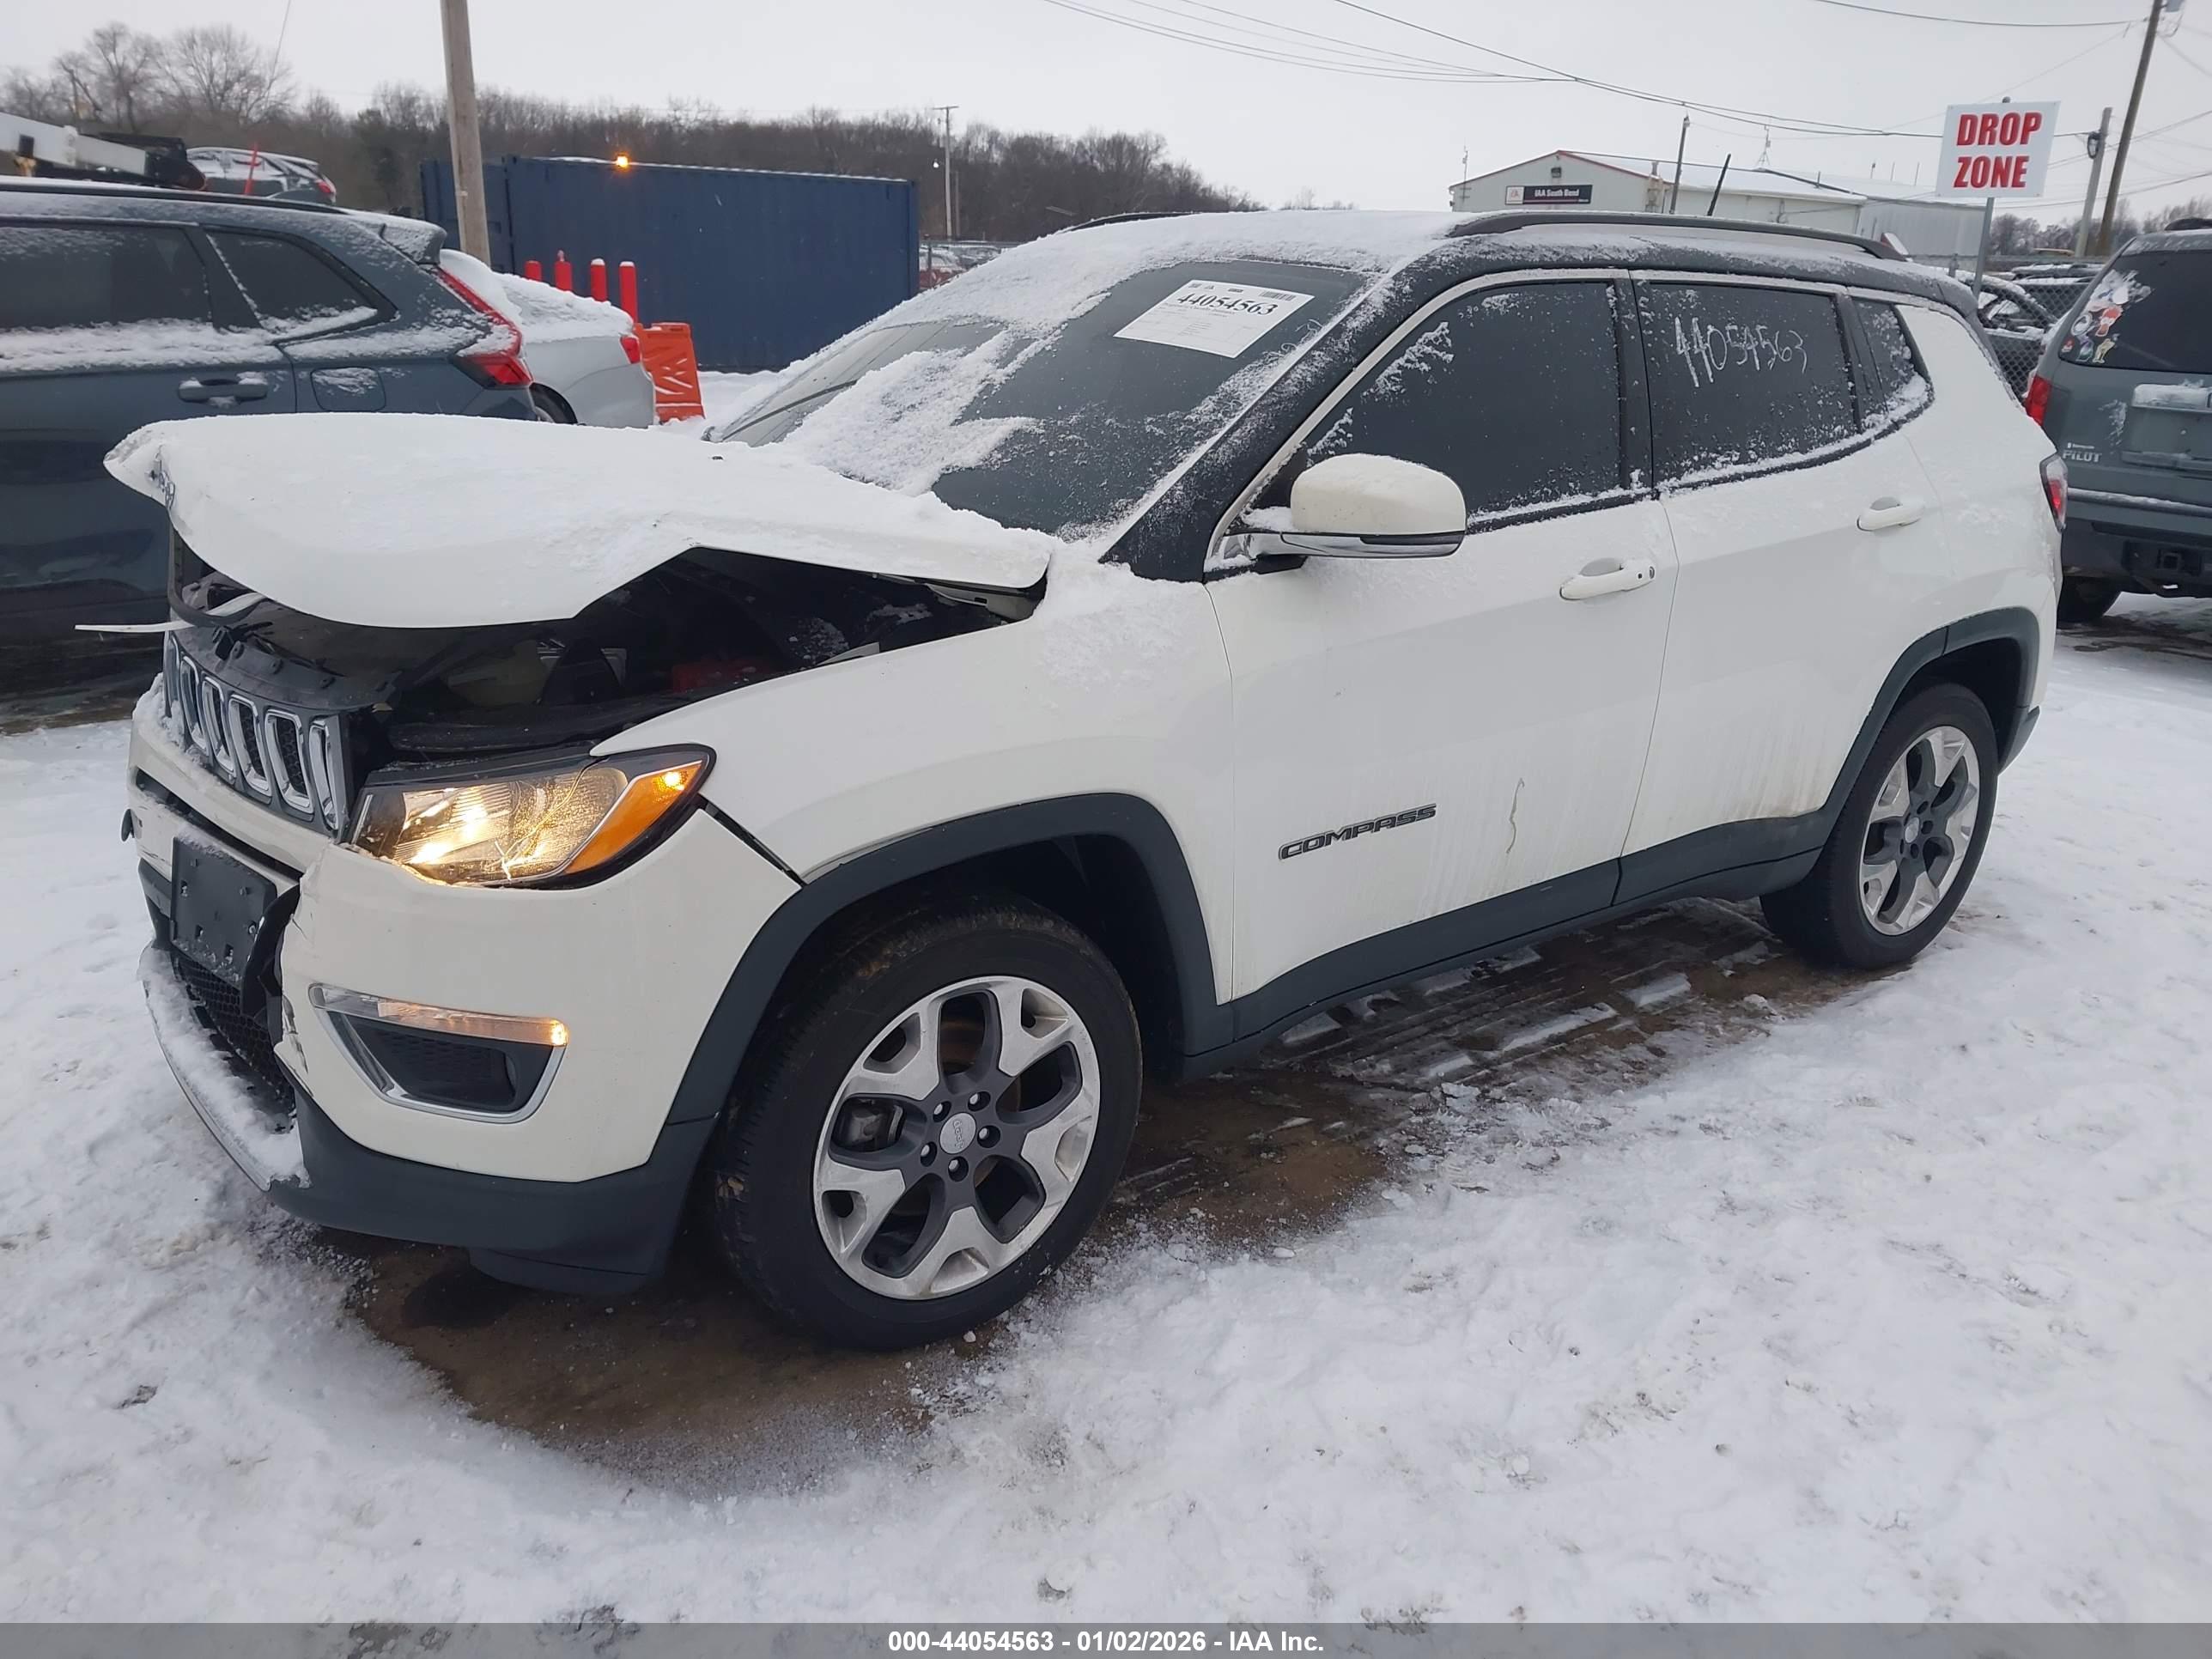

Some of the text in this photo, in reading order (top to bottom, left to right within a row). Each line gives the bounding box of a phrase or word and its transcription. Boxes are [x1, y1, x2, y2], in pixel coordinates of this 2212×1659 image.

[1956, 112, 2043, 146] DROP
[1953, 155, 2030, 188] ZONE
[1176, 292, 1279, 315] 44054563
[1674, 316, 1808, 387] 44054563
[2063, 450, 2103, 463] PILOT
[1278, 803, 1437, 860] COMPASS
